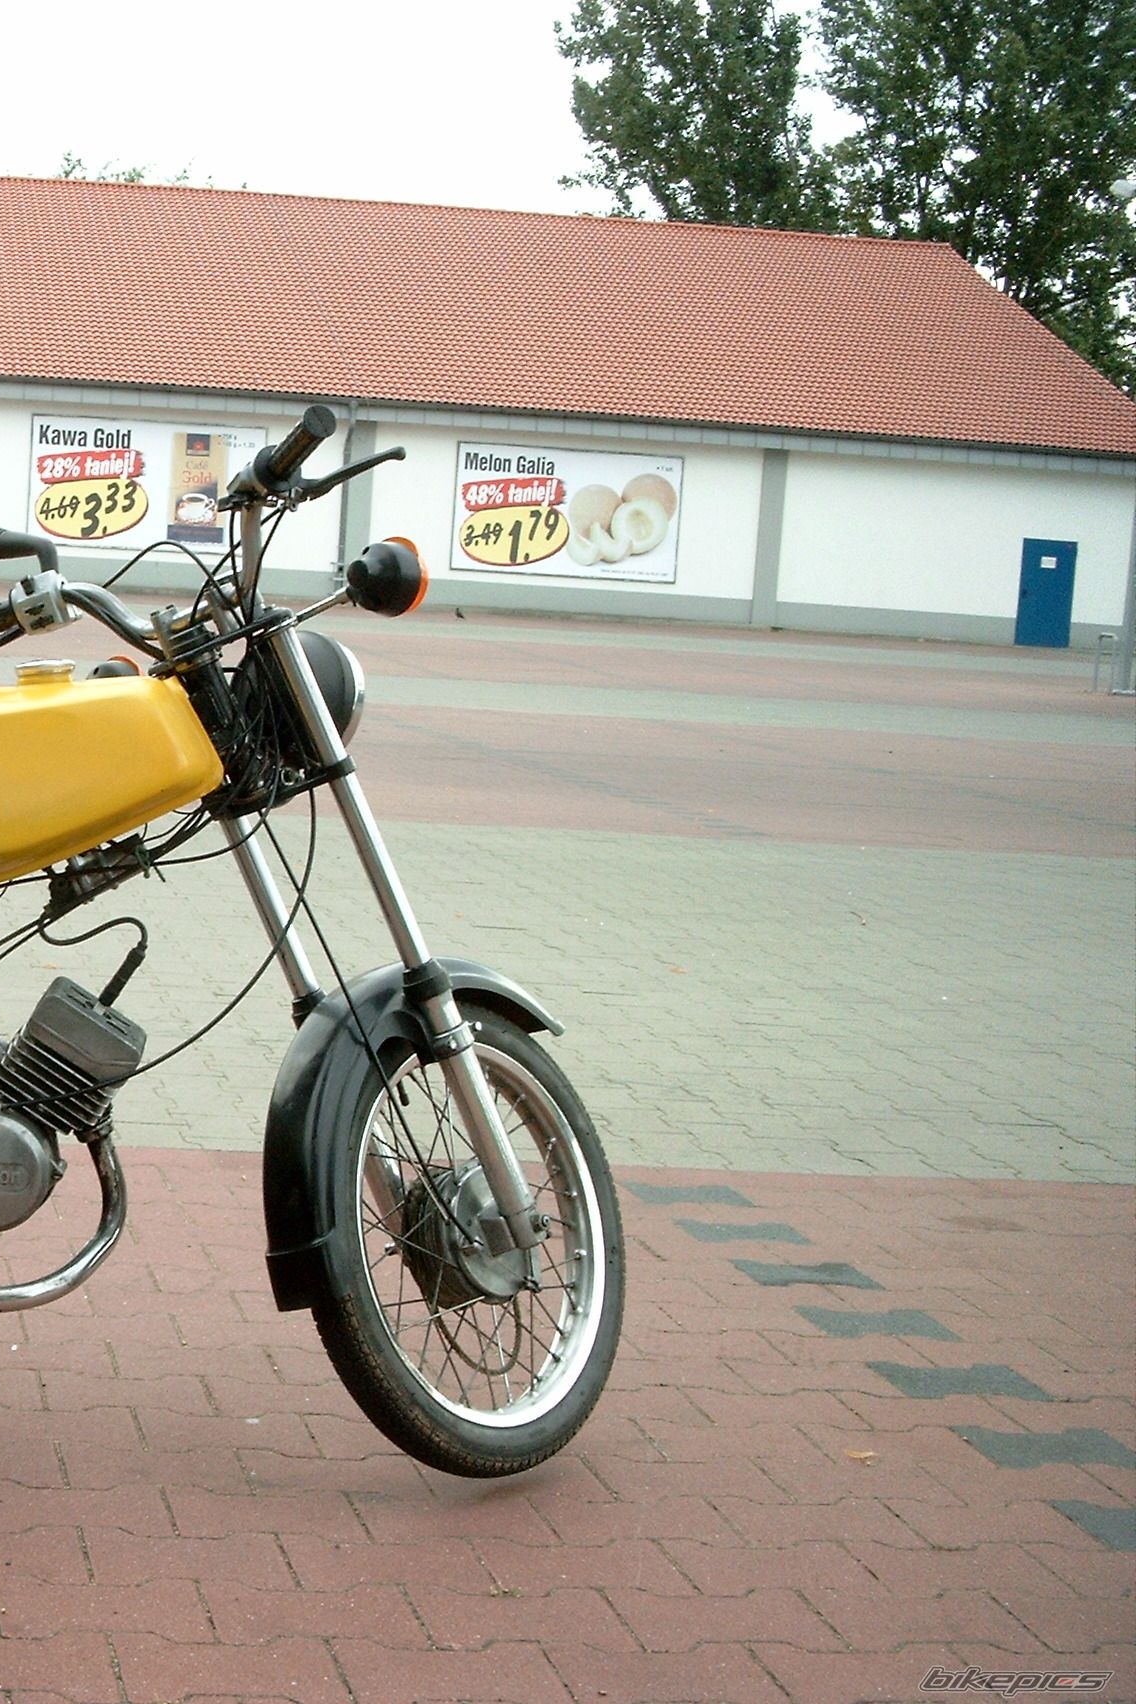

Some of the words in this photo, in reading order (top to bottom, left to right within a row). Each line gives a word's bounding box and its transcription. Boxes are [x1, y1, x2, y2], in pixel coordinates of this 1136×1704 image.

[38, 424, 87, 447] Kawa
[93, 428, 132, 449] Gold
[41, 456, 81, 479] 28%
[85, 450, 135, 479] taniej!
[464, 452, 512, 473] Melon
[516, 456, 555, 475] Galia
[465, 483, 503, 506] 48%
[508, 479, 557, 507] taniej!
